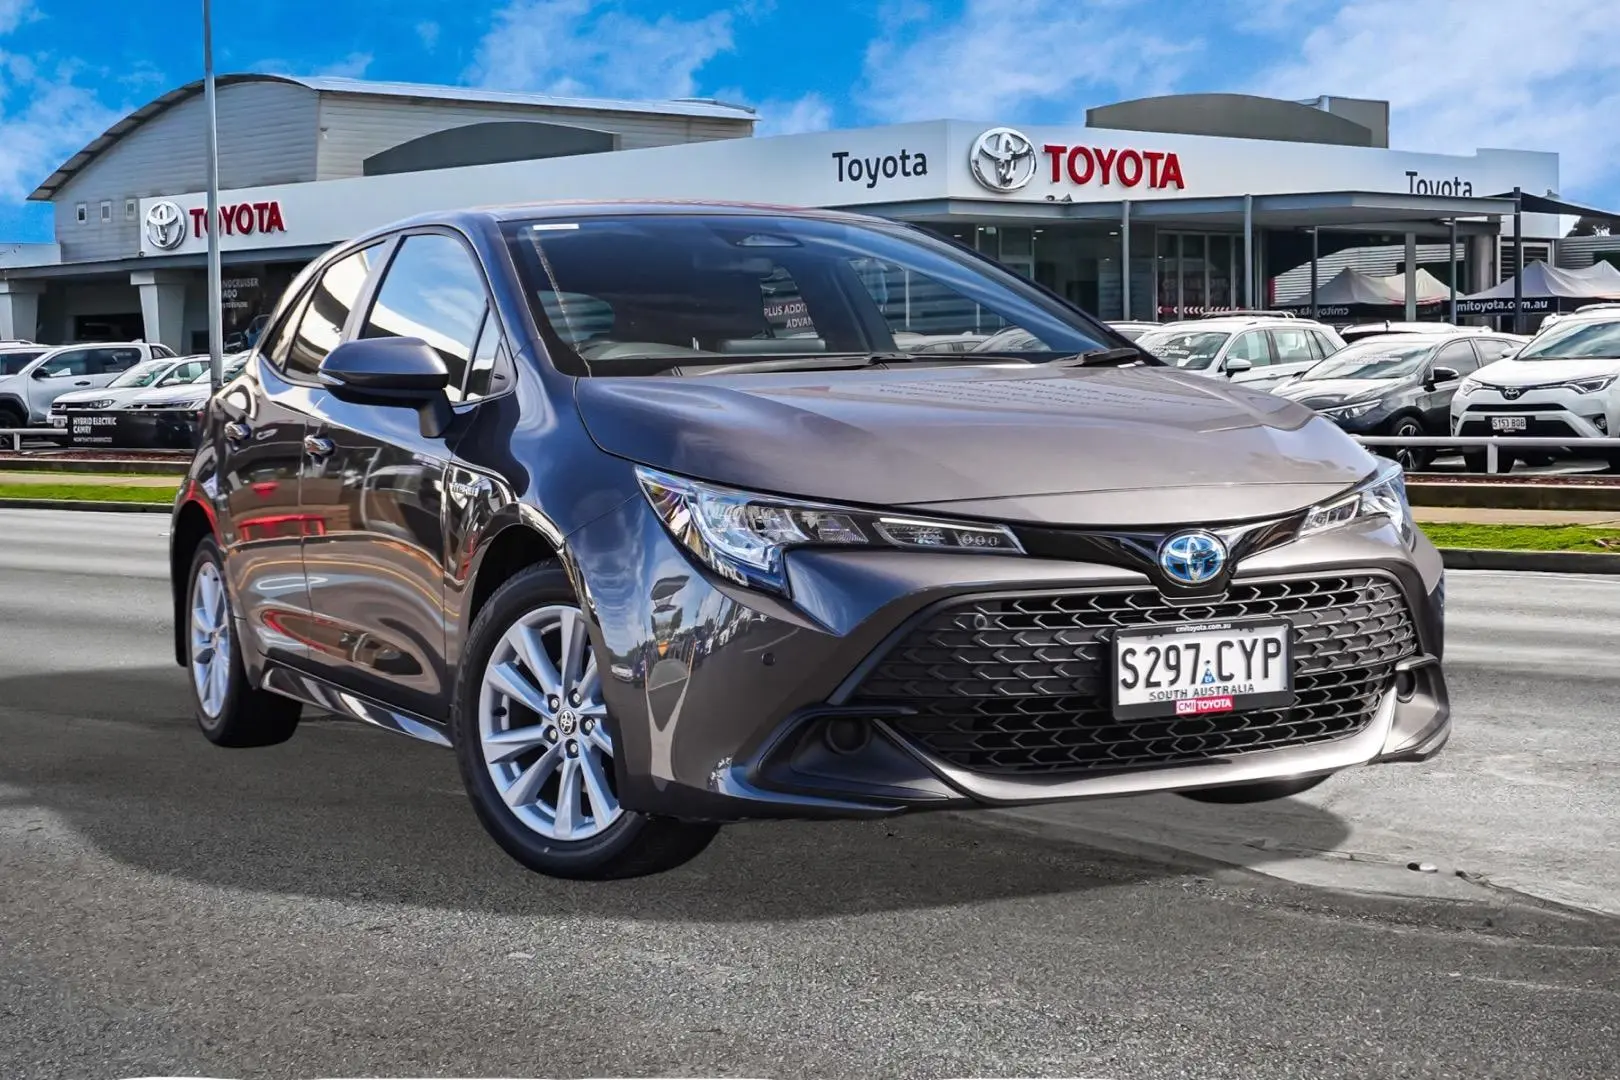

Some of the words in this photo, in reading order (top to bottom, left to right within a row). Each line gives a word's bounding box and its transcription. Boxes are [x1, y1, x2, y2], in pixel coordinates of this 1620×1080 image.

[832, 148, 928, 189] Toyota
[1042, 144, 1184, 190] TOYOTA
[1405, 170, 1473, 198] Toyota
[764, 305, 783, 317] PLUS
[1457, 299, 1548, 313] mitoyota.cm.au
[1176, 623, 1232, 633] cmitoyota.com.au
[1120, 642, 1201, 690] S297
[1217, 637, 1282, 682] CYP
[1149, 689, 1188, 701] SOUTH
[1193, 683, 1255, 697] AUSTRALIA
[1196, 698, 1232, 710] TOYOTA
